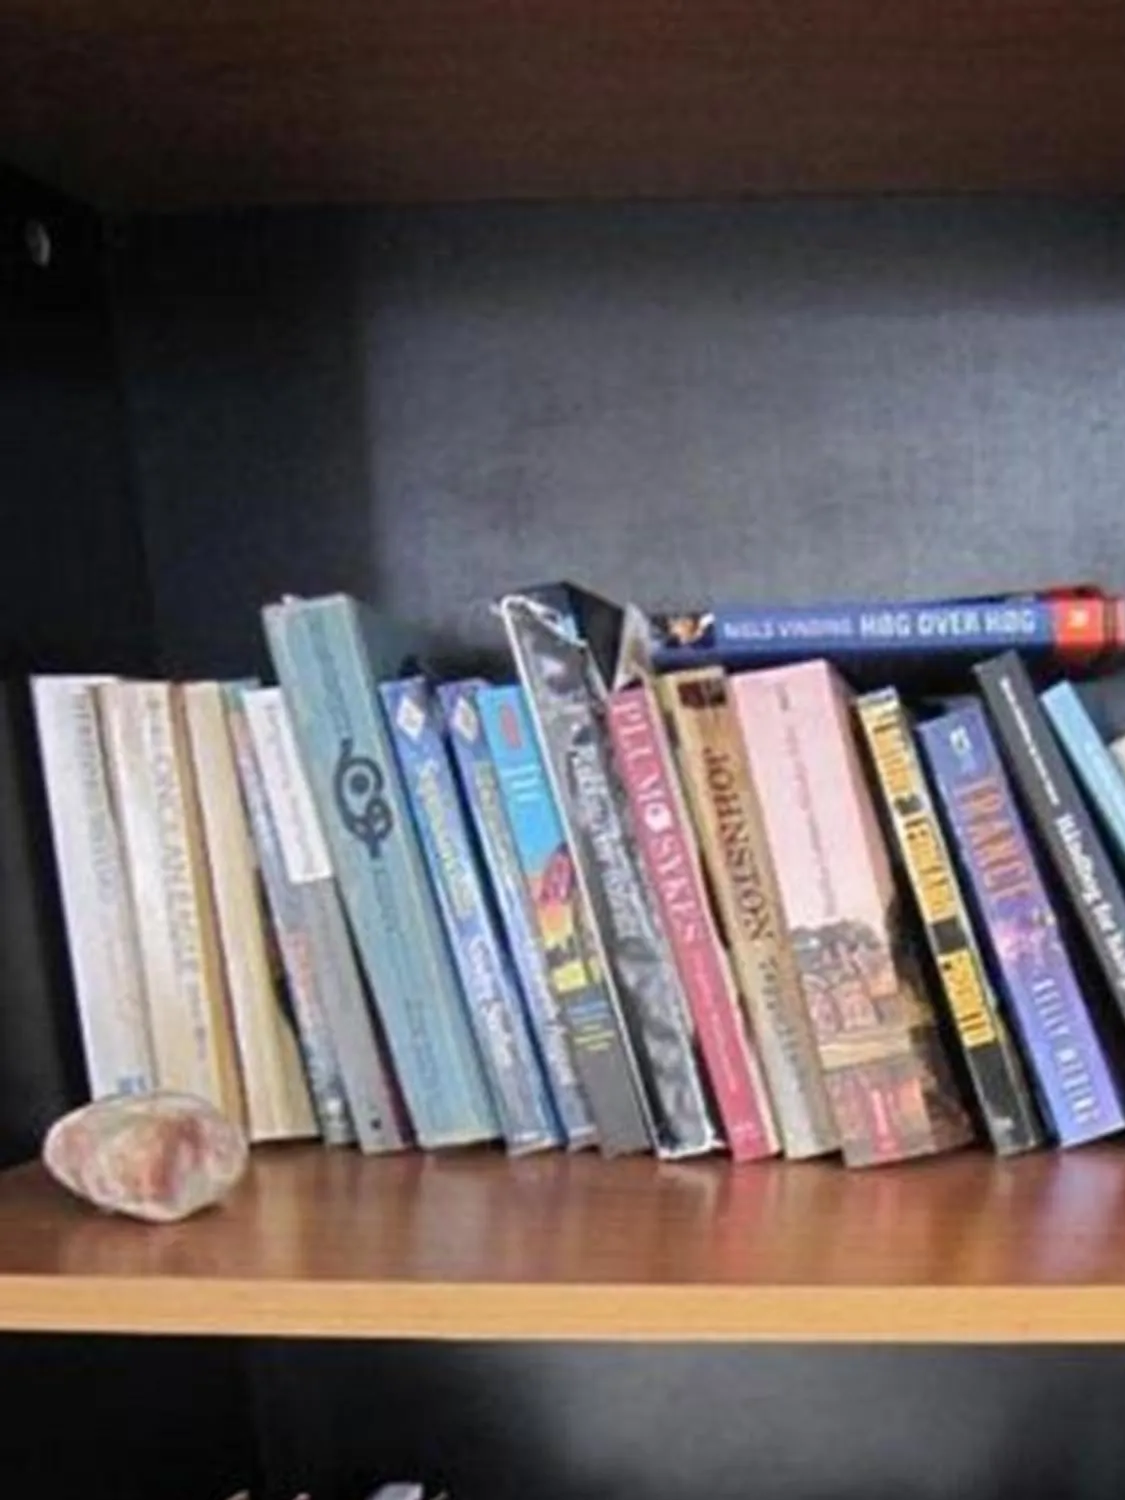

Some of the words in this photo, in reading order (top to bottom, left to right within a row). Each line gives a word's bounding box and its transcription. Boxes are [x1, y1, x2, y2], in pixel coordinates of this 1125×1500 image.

[916, 609, 979, 635] OVER
[614, 698, 663, 802] PLUM
[653, 832, 704, 943] SYKES
[701, 744, 772, 942] JOHNSTON
[953, 774, 1034, 905] TRANCE
